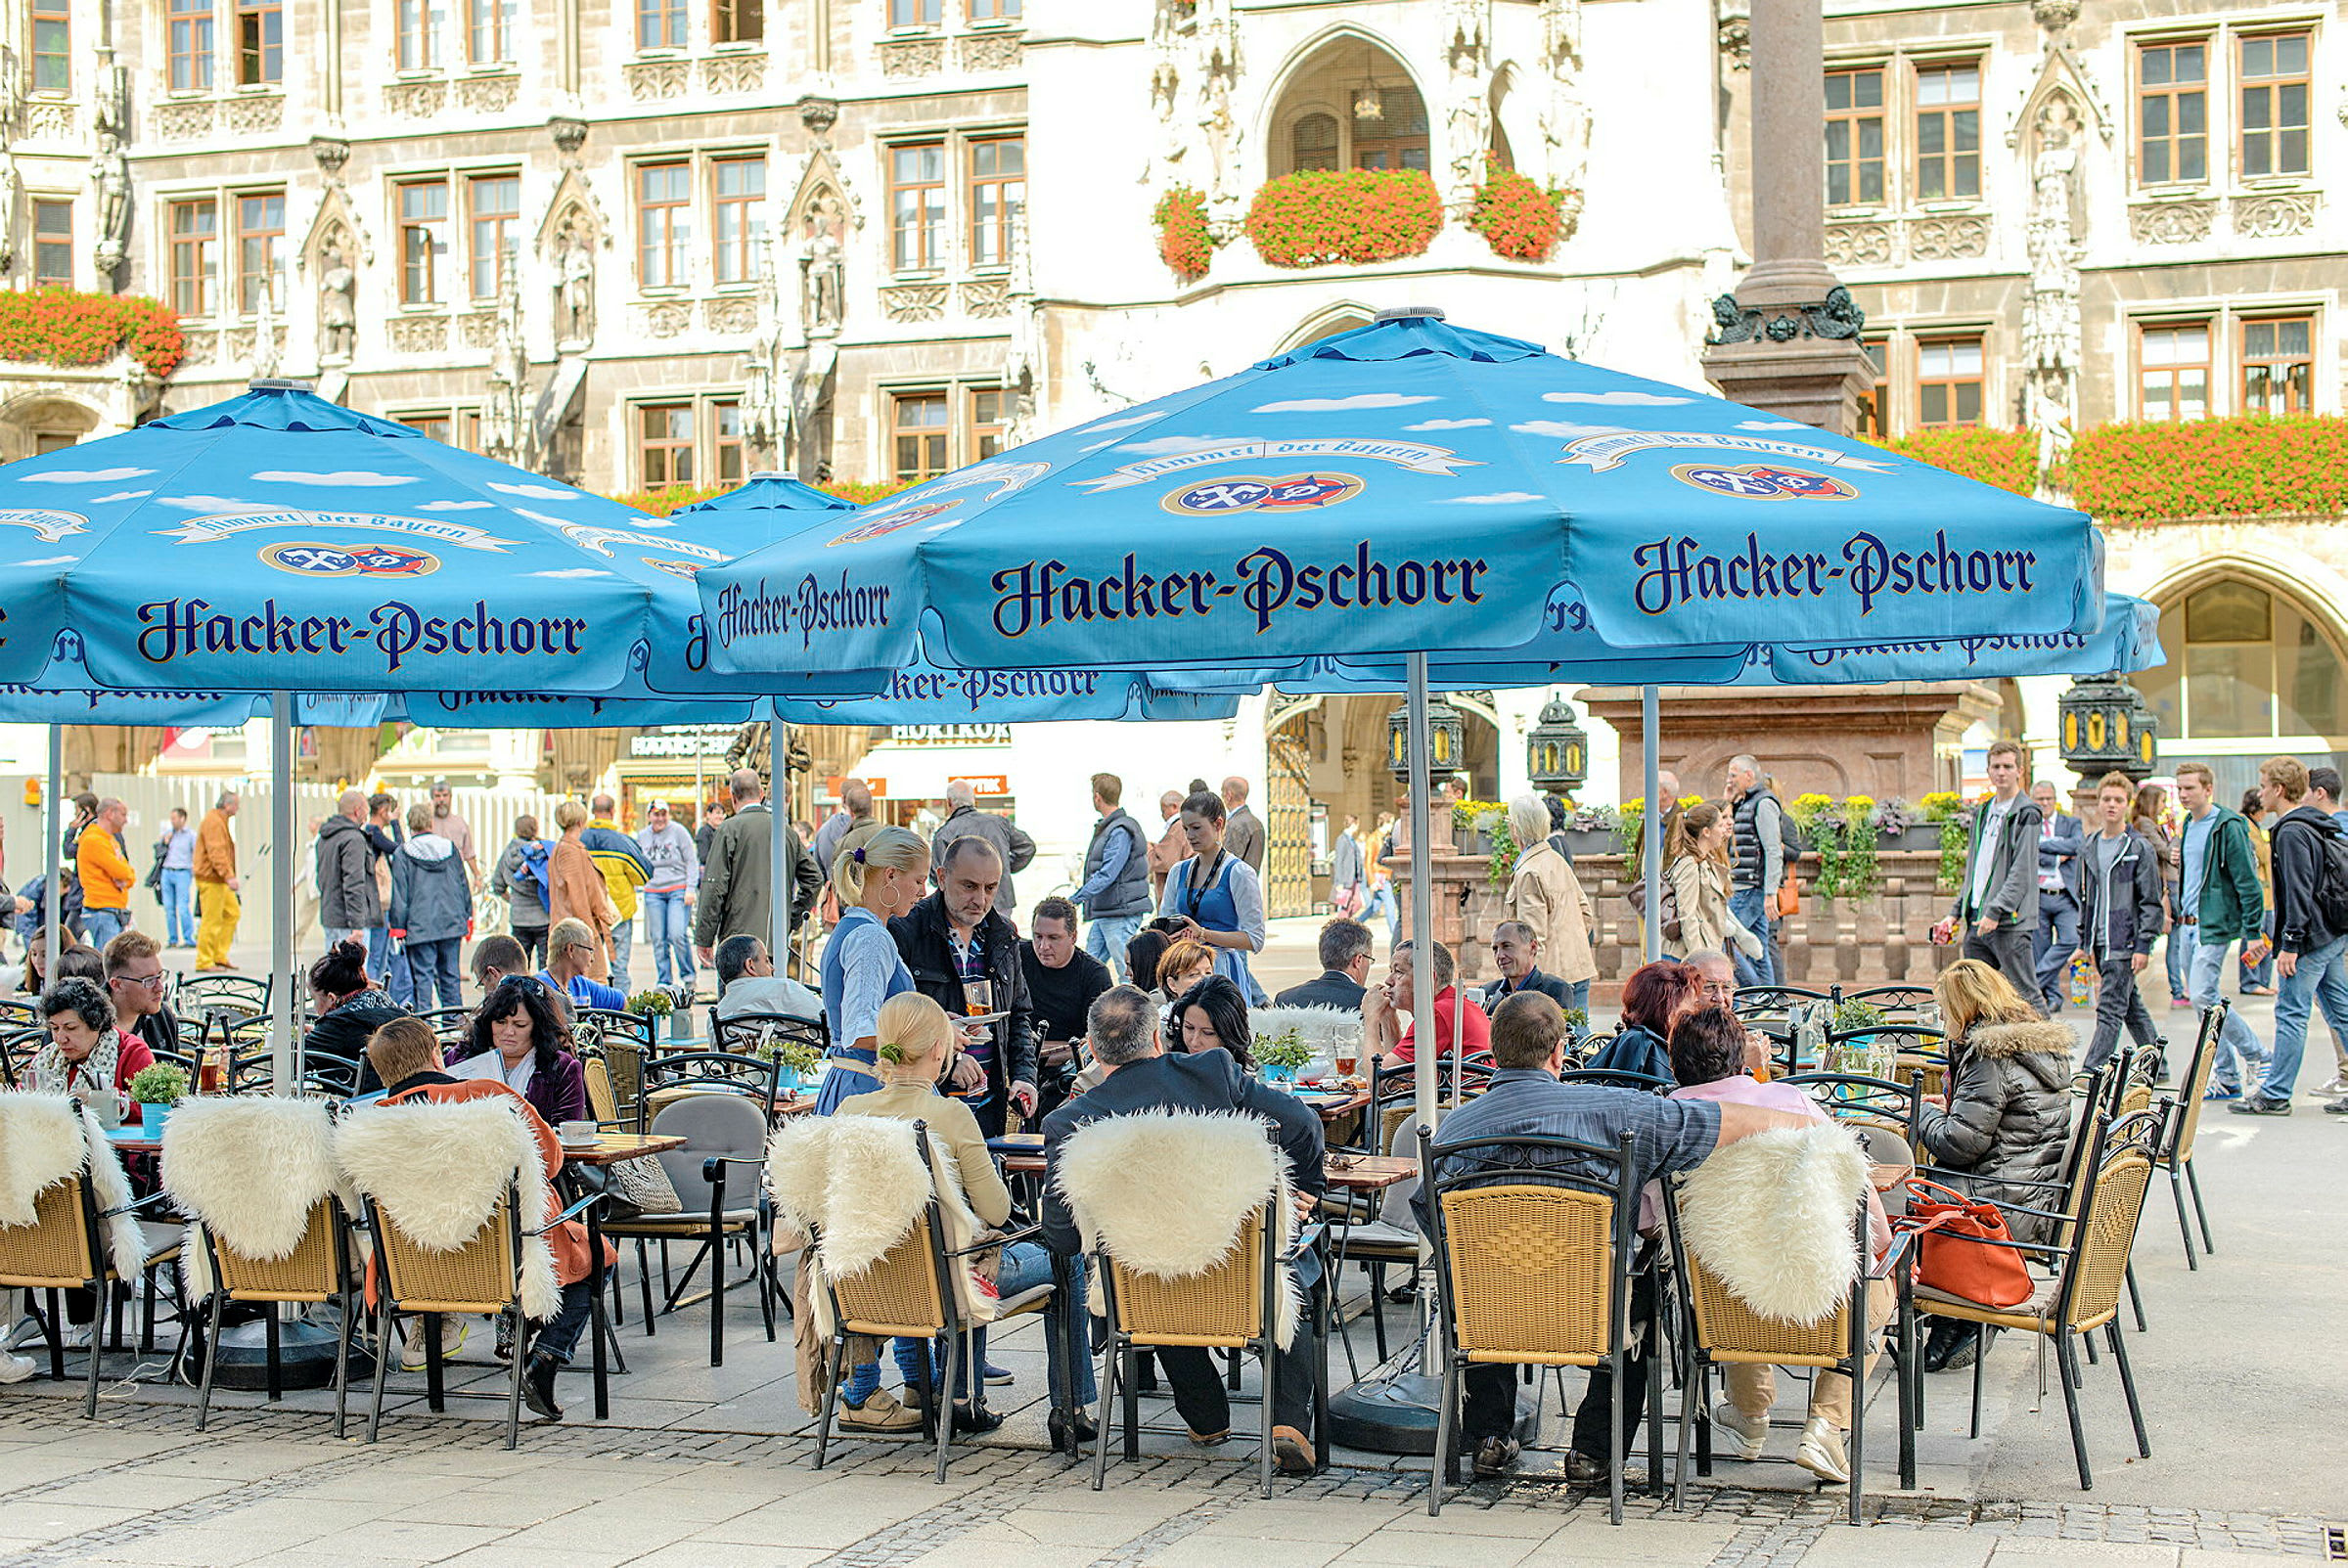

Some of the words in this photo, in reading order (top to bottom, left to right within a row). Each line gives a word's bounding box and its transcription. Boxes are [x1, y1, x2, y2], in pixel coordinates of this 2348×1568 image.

[1278, 443, 1326, 452] der
[1332, 440, 1430, 460] Bayern
[1712, 435, 1826, 458] Bayern
[317, 513, 359, 523] der
[370, 515, 467, 538] Bayern
[990, 538, 1488, 640] Hacker-Pschorr
[1633, 527, 2038, 619] Hacker-Pschorr
[136, 597, 587, 674] Hacker-Pschorr
[718, 567, 890, 652] Hacker-Pschorr
[874, 668, 1101, 712] ker-Pschorr
